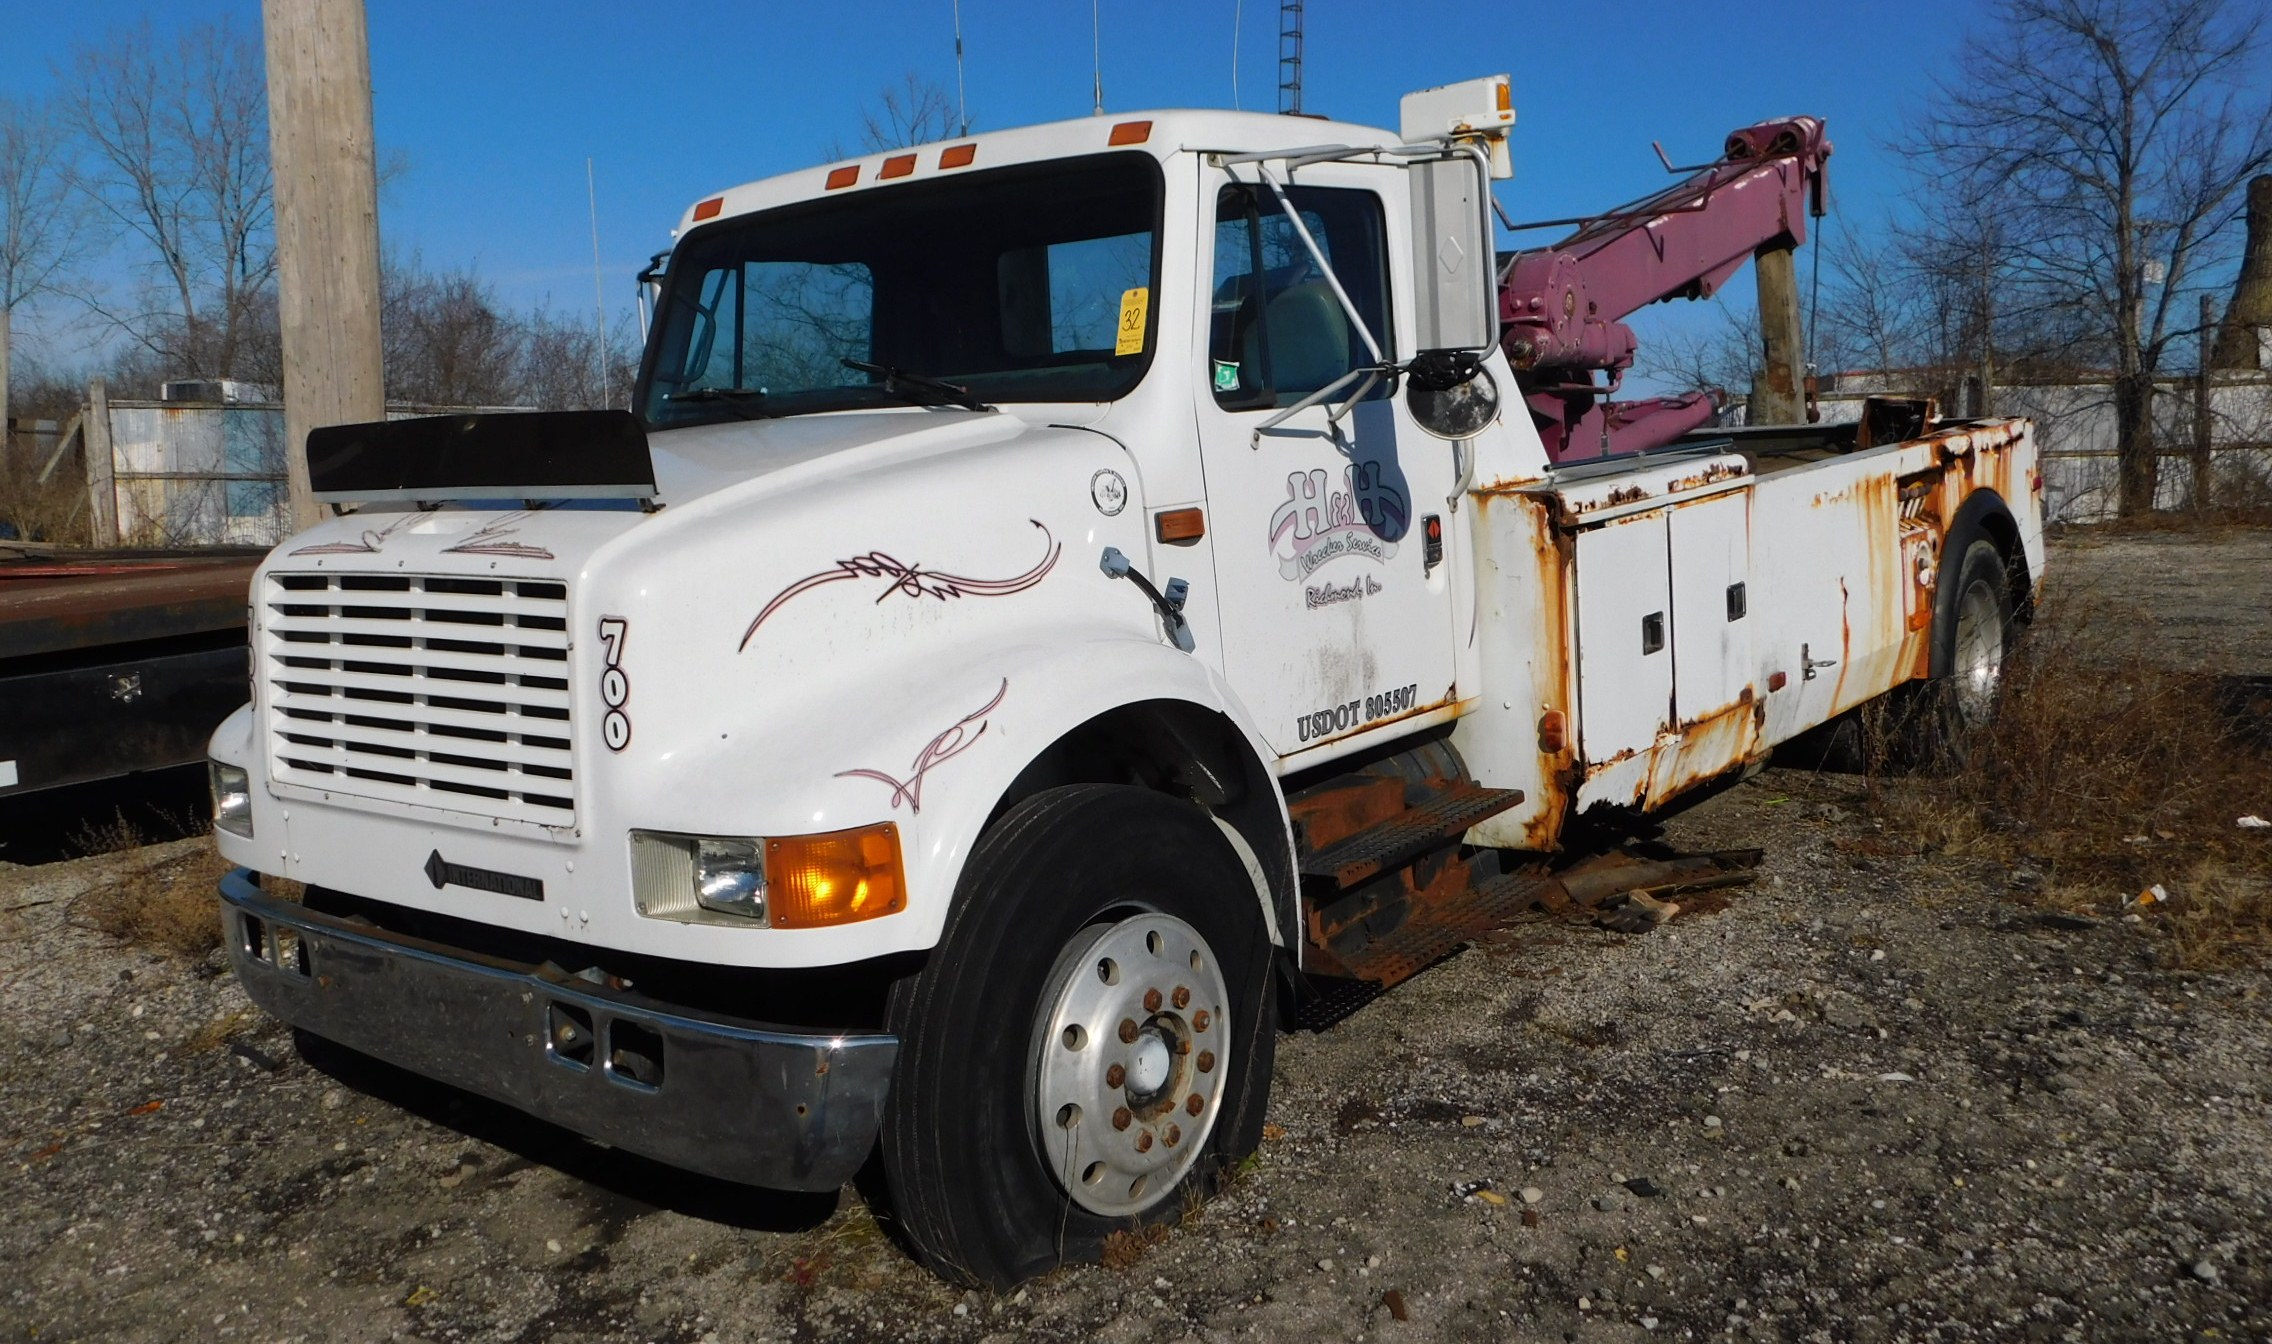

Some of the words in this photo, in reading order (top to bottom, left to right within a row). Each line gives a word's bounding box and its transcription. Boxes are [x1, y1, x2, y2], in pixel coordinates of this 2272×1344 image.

[1122, 307, 1140, 331] 32
[1346, 531, 1382, 558] Service
[599, 618, 631, 752] 700
[1297, 699, 1361, 741] USDOT
[1365, 683, 1417, 722] 805507
